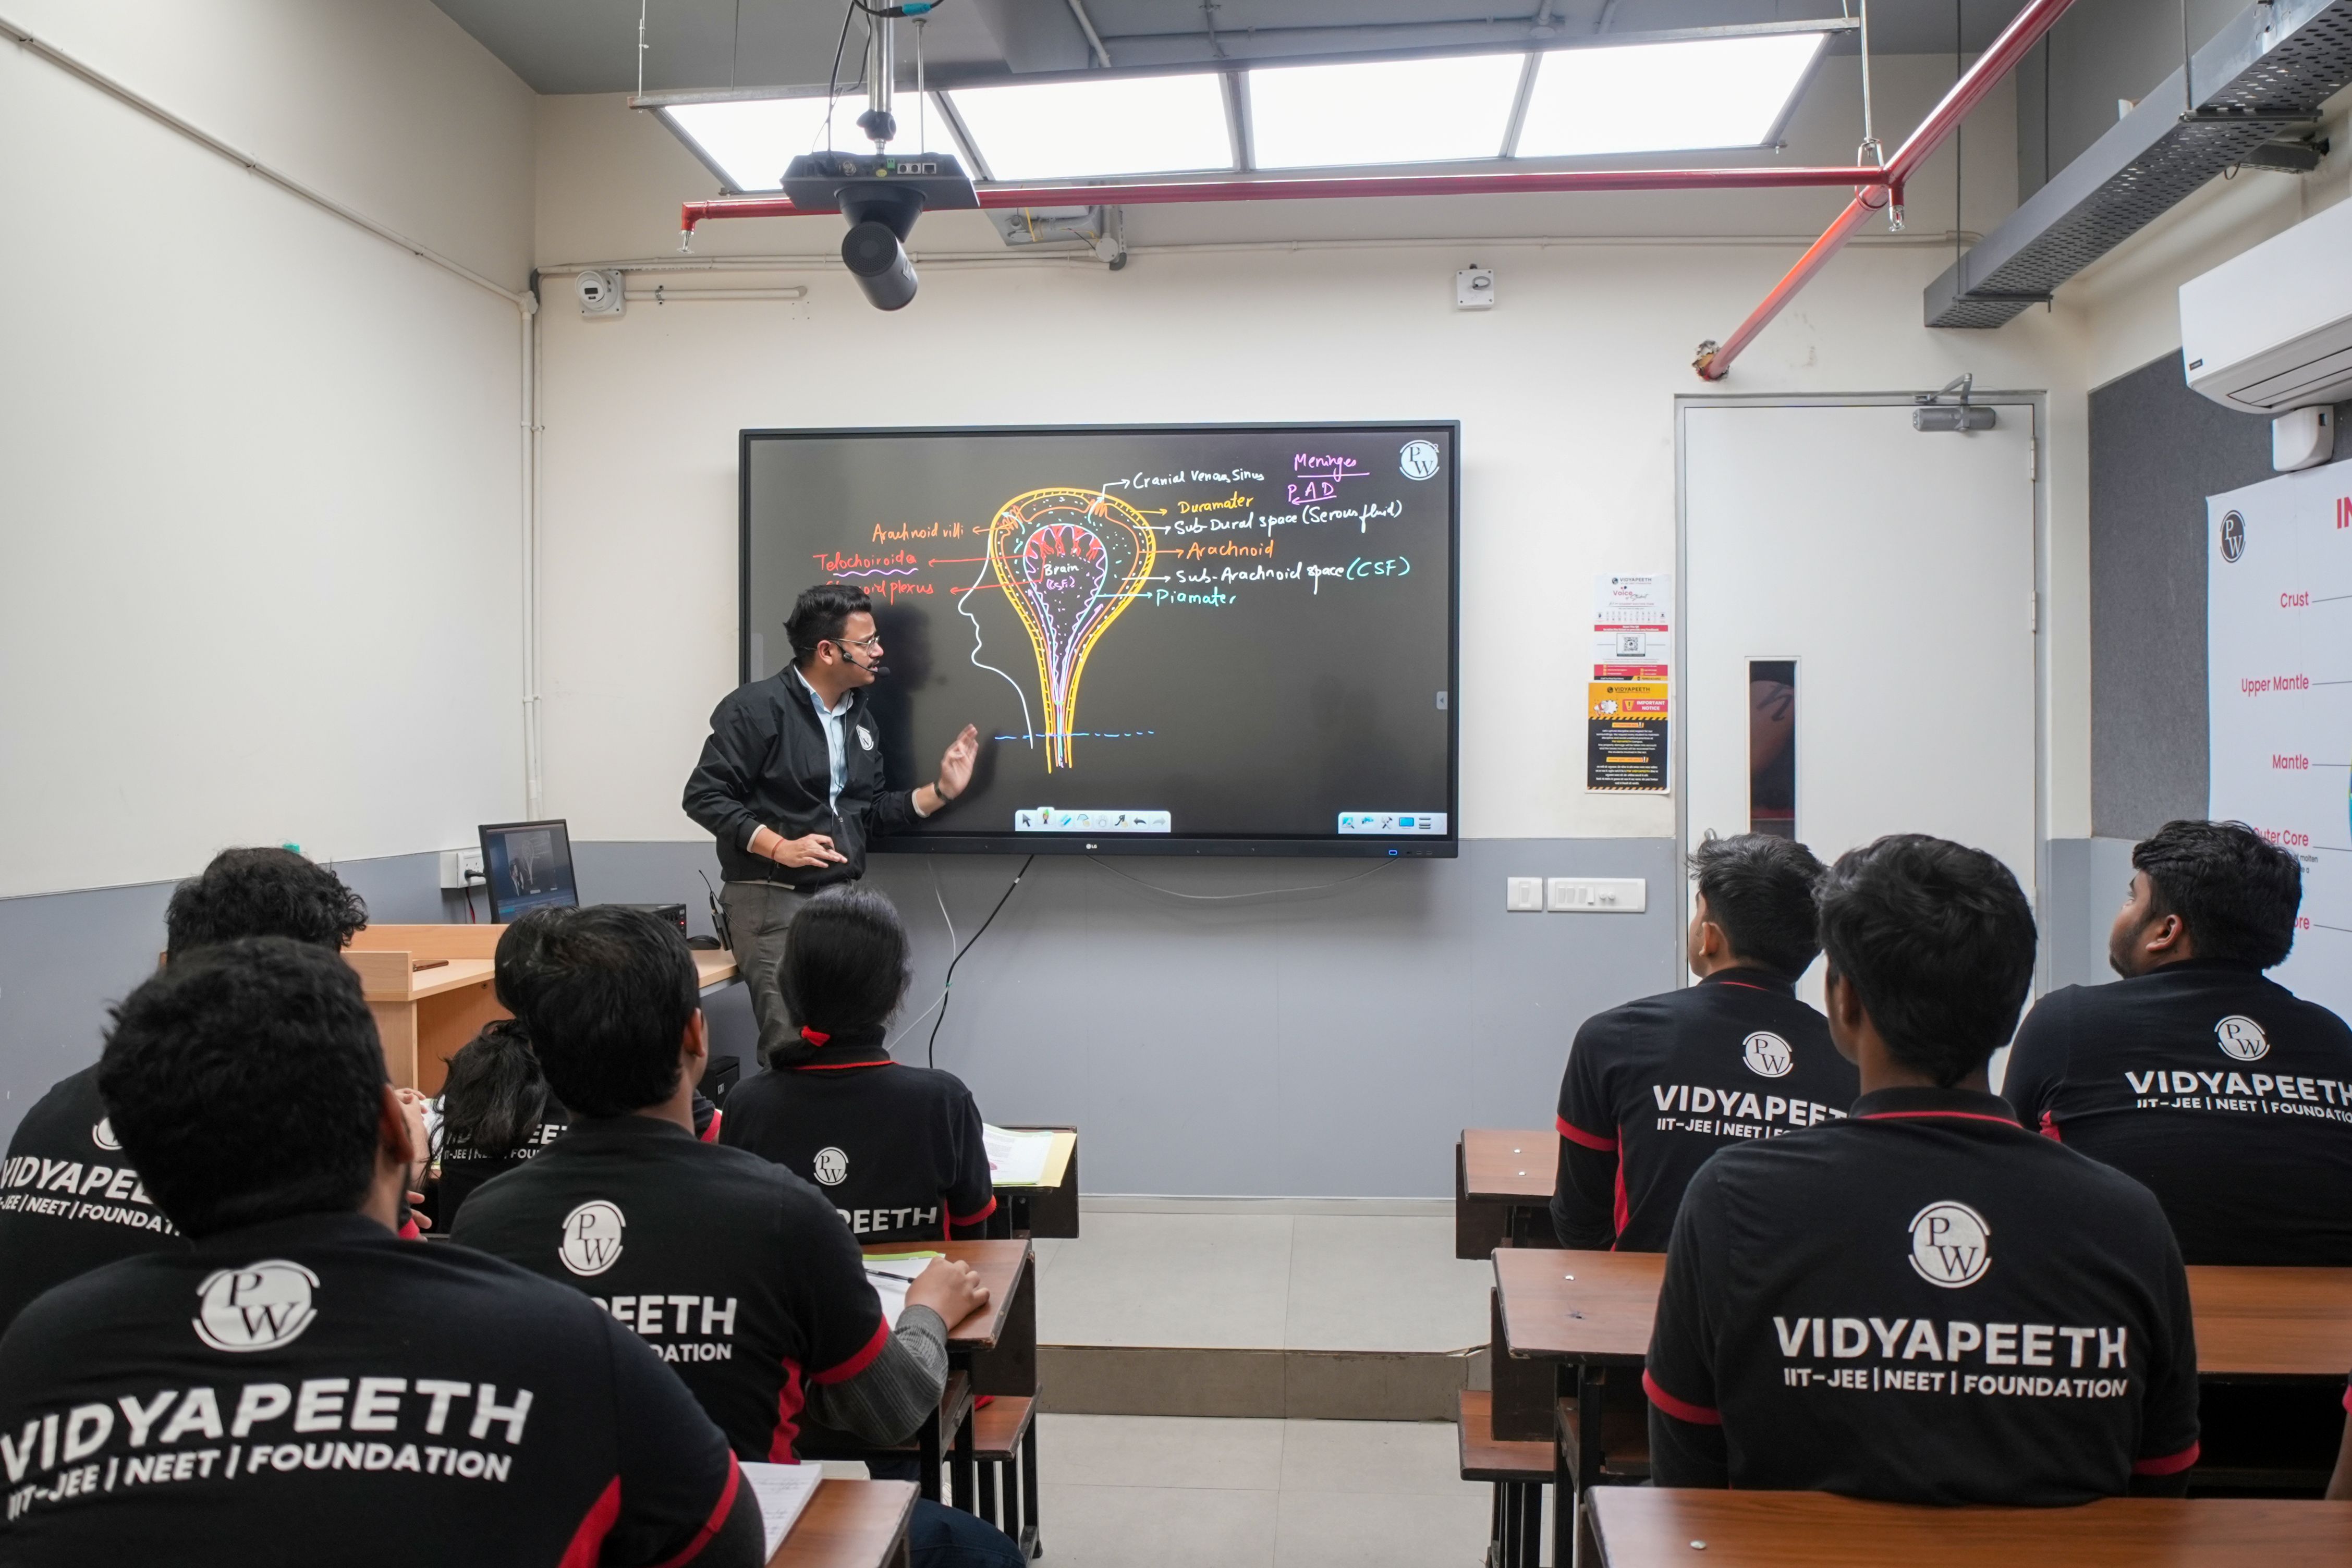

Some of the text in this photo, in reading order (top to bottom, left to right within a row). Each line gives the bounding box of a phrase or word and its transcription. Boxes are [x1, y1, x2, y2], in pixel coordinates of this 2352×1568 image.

[1133, 471, 1186, 489] Cranial
[1232, 468, 1264, 481] Sinus
[1294, 454, 1357, 482] Meninges
[1177, 491, 1254, 514] Duramater
[1259, 515, 1297, 537] space
[1302, 505, 1358, 524] (Serous
[1186, 540, 1274, 560] Arachnoid
[1043, 564, 1079, 576] Brain
[1307, 565, 1345, 595] space
[1346, 556, 1410, 580] (CSF)
[890, 580, 934, 606] plexus
[1156, 586, 1236, 607] Piamater
[2281, 592, 2309, 608] Crust
[2242, 675, 2309, 697] Upper Mantle
[2273, 754, 2309, 769] Mantle
[2283, 830, 2309, 847] Core
[2125, 1071, 2352, 1106] VIDYAPEETH
[2137, 1097, 2201, 1109] IIT-JEE
[2215, 1099, 2257, 1112] NEET
[1657, 1118, 1711, 1134] IIT-JEE
[1723, 1124, 1762, 1138] NEET
[26, 1197, 70, 1216] NEET
[78, 1204, 180, 1237] FOUNDAT
[1773, 1317, 2127, 1369] VIDYAPEETH
[1784, 1367, 2128, 1398] IIT-JEE NEET FOUNDATION
[0, 1377, 533, 1484] VIDYAPEETH
[7, 1442, 513, 1522] IIT-JEE NEET FOUNDATION
